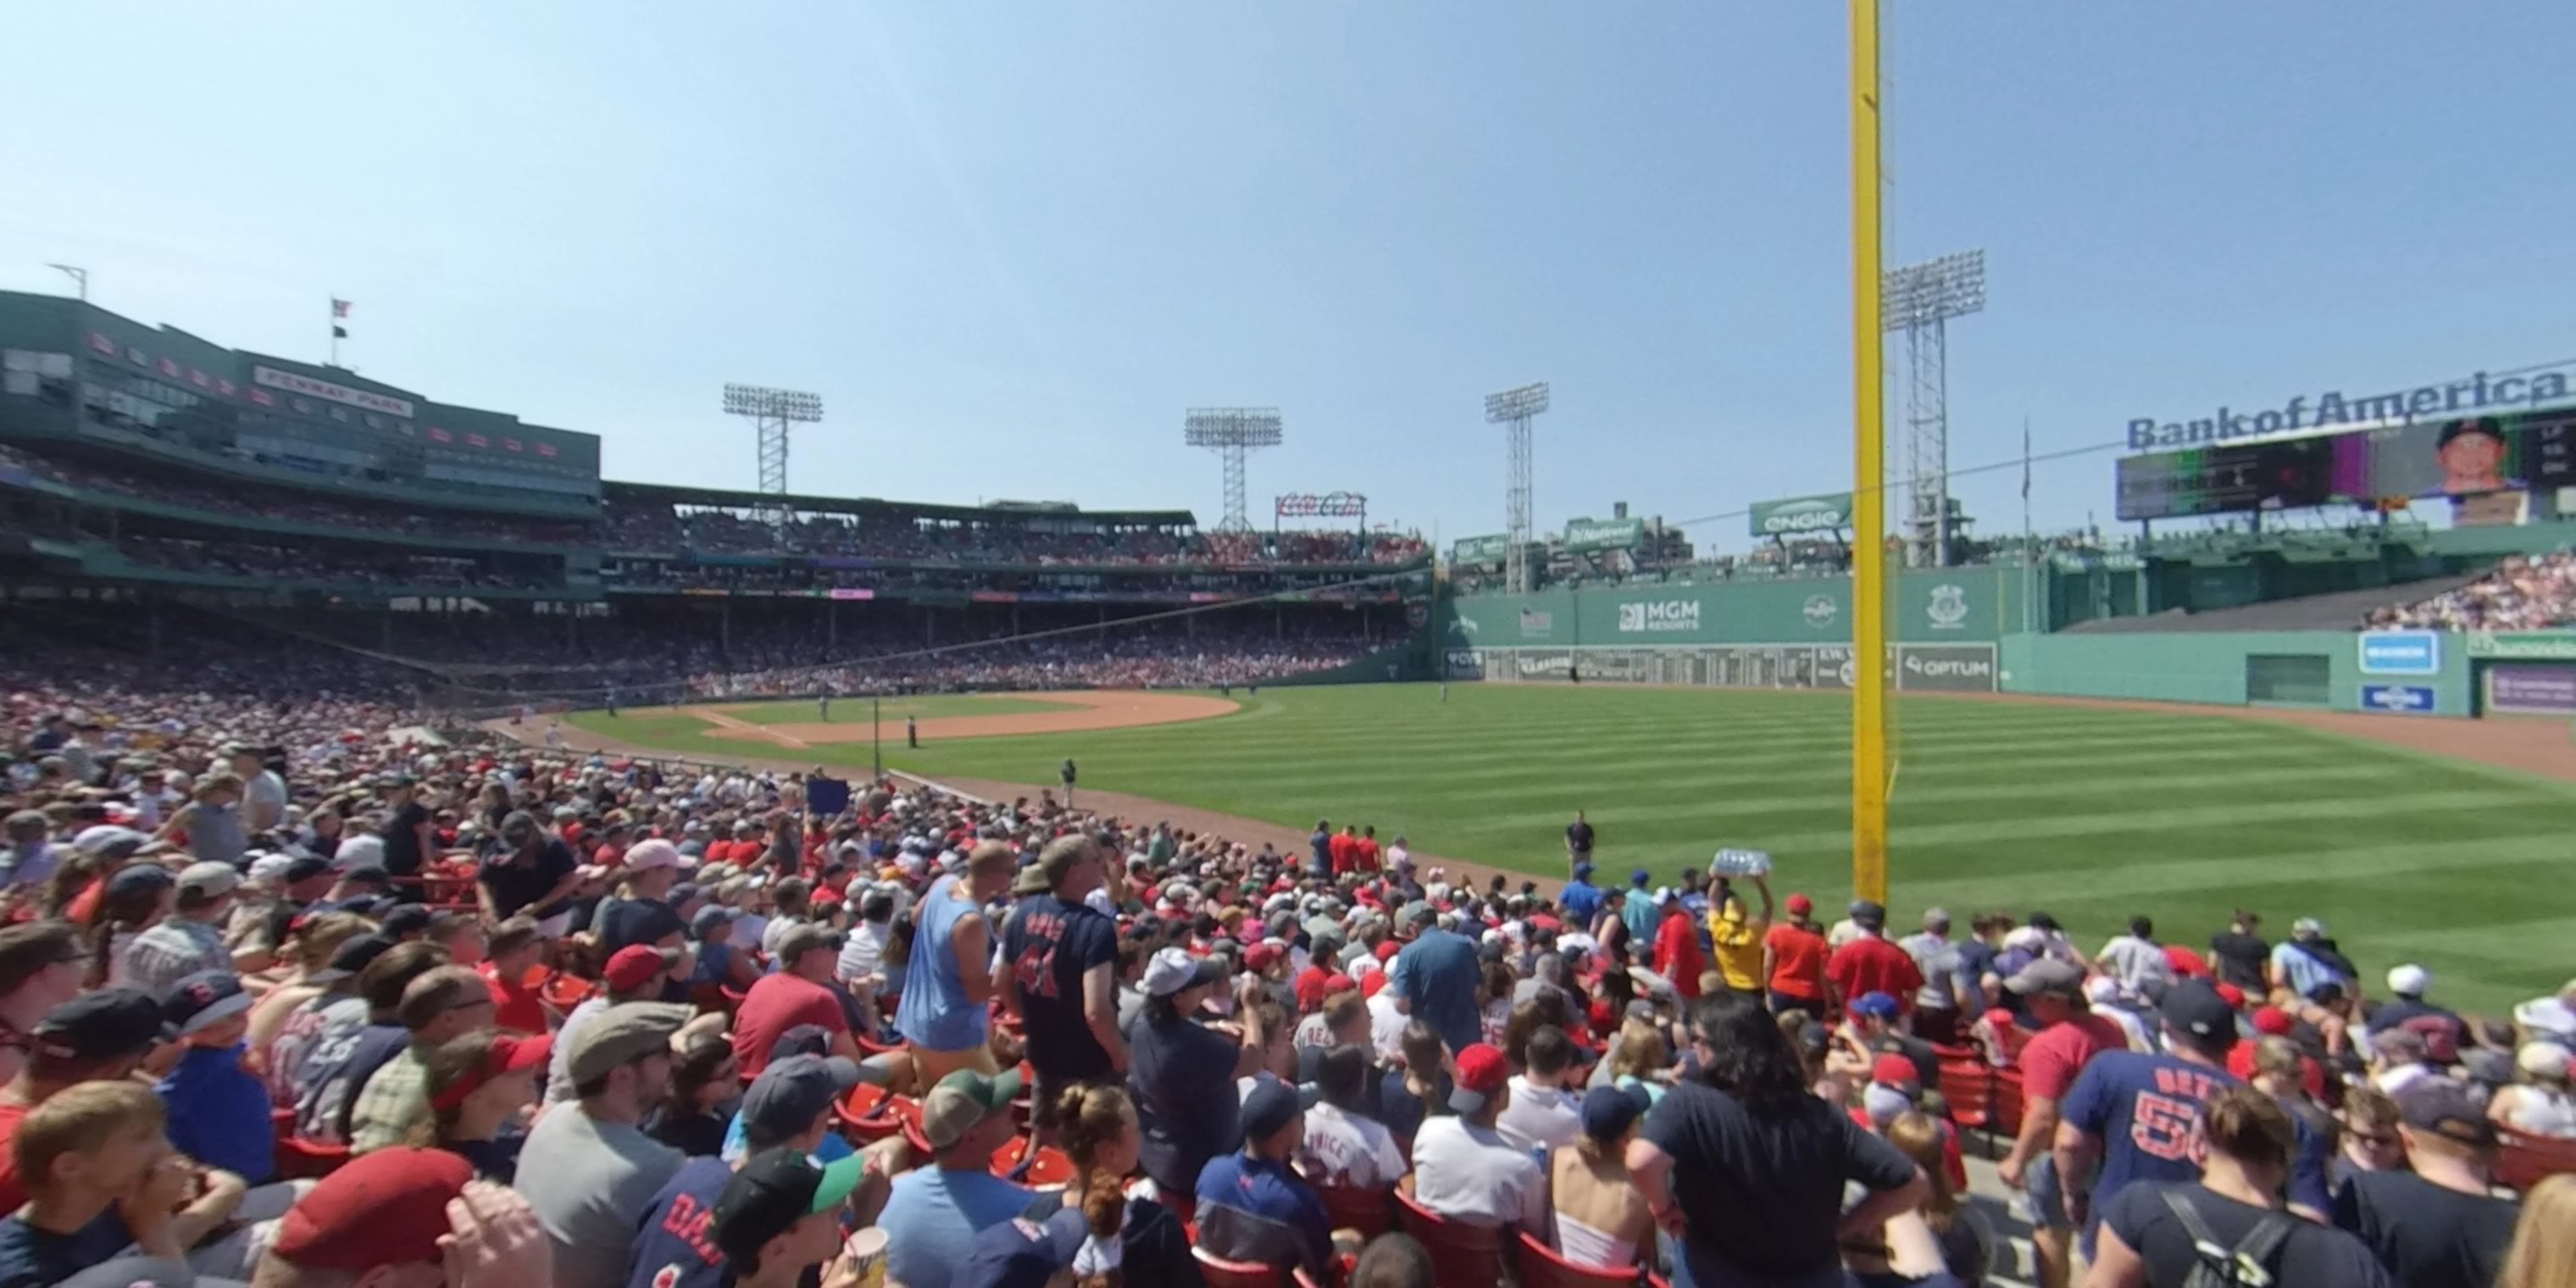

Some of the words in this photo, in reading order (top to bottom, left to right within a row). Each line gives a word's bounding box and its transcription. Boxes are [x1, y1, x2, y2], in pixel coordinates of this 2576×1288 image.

[357, 393, 409, 414] PARK
[2127, 405, 2245, 451] Bank
[2253, 394, 2305, 435] of
[2312, 370, 2568, 427] America
[1648, 600, 1699, 620] MGM
[1647, 619, 1699, 631] RESORTS
[1924, 660, 1990, 676] OPTUM
[2131, 1089, 2208, 1166] 5
